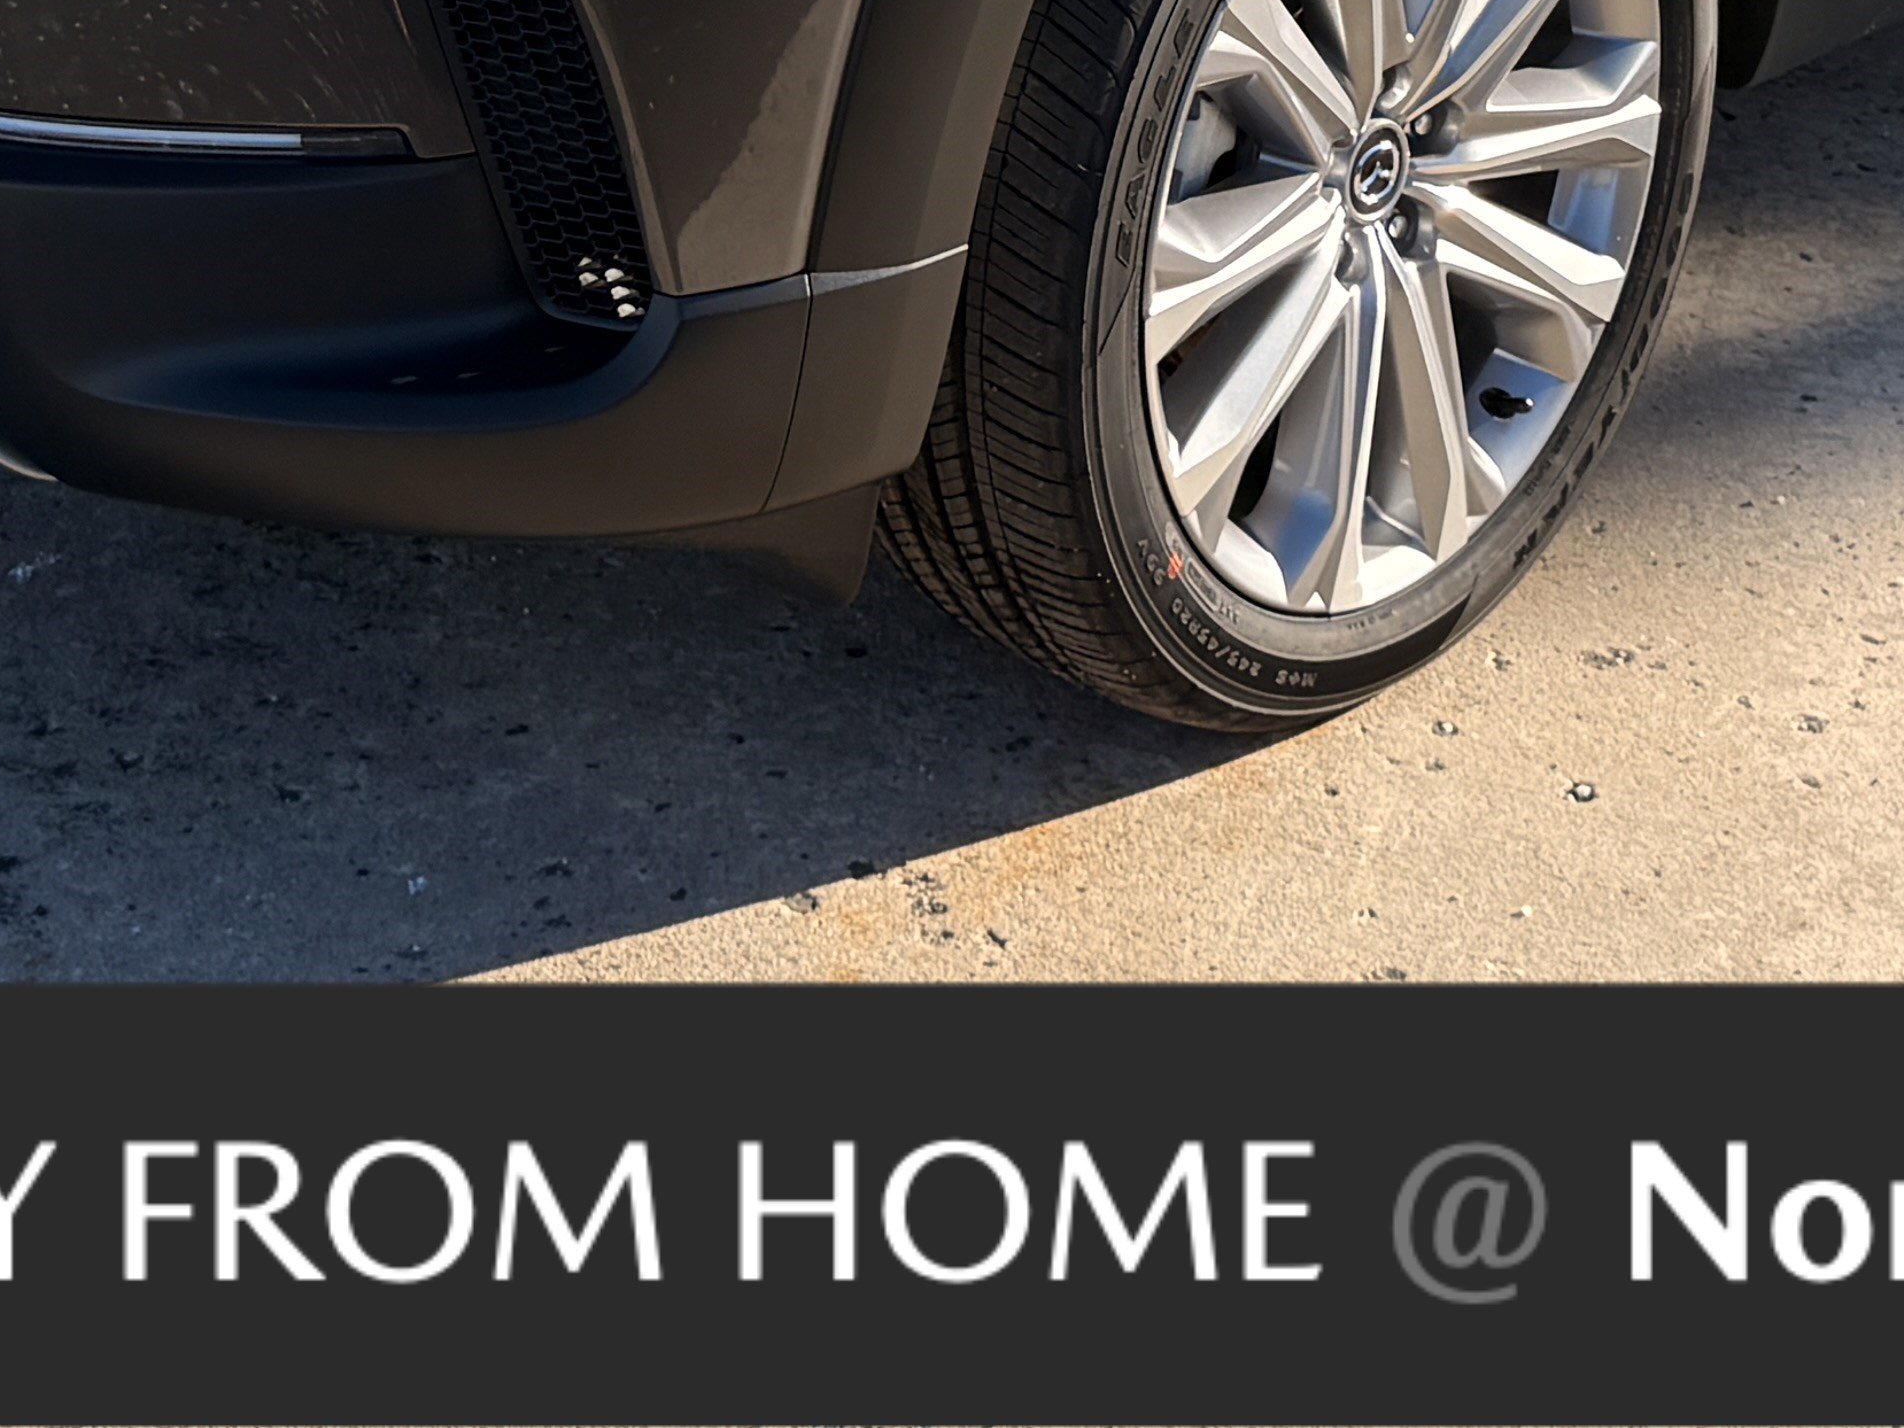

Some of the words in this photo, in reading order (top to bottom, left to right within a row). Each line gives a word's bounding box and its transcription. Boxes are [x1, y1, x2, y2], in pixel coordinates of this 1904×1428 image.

[1116, 9, 1194, 268] EAGLE
[1137, 538, 1165, 586] 99V
[1172, 597, 1262, 677] 245/45R20
